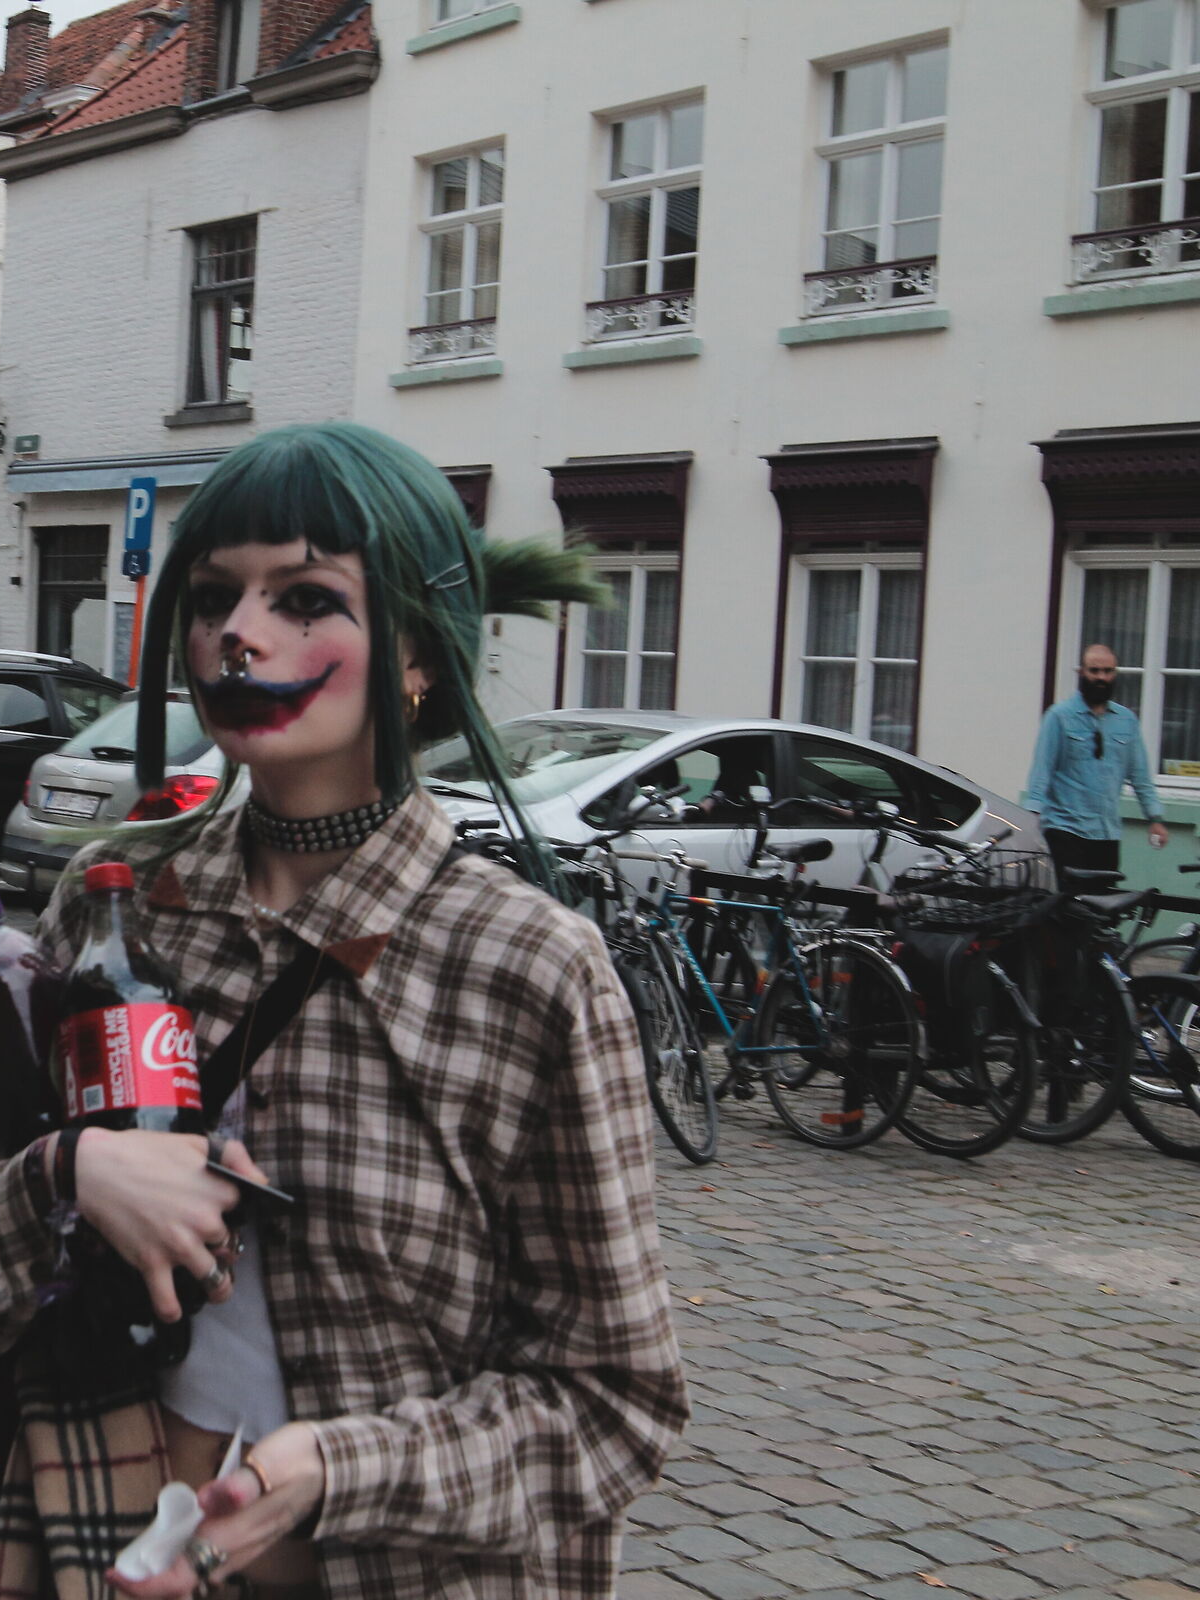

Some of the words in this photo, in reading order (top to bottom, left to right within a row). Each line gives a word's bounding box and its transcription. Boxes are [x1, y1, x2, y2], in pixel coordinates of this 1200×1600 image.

[127, 488, 150, 539] P
[103, 1008, 118, 1035] ME
[115, 1007, 131, 1056] AGAIN
[106, 1036, 125, 1107] RECYCLE
